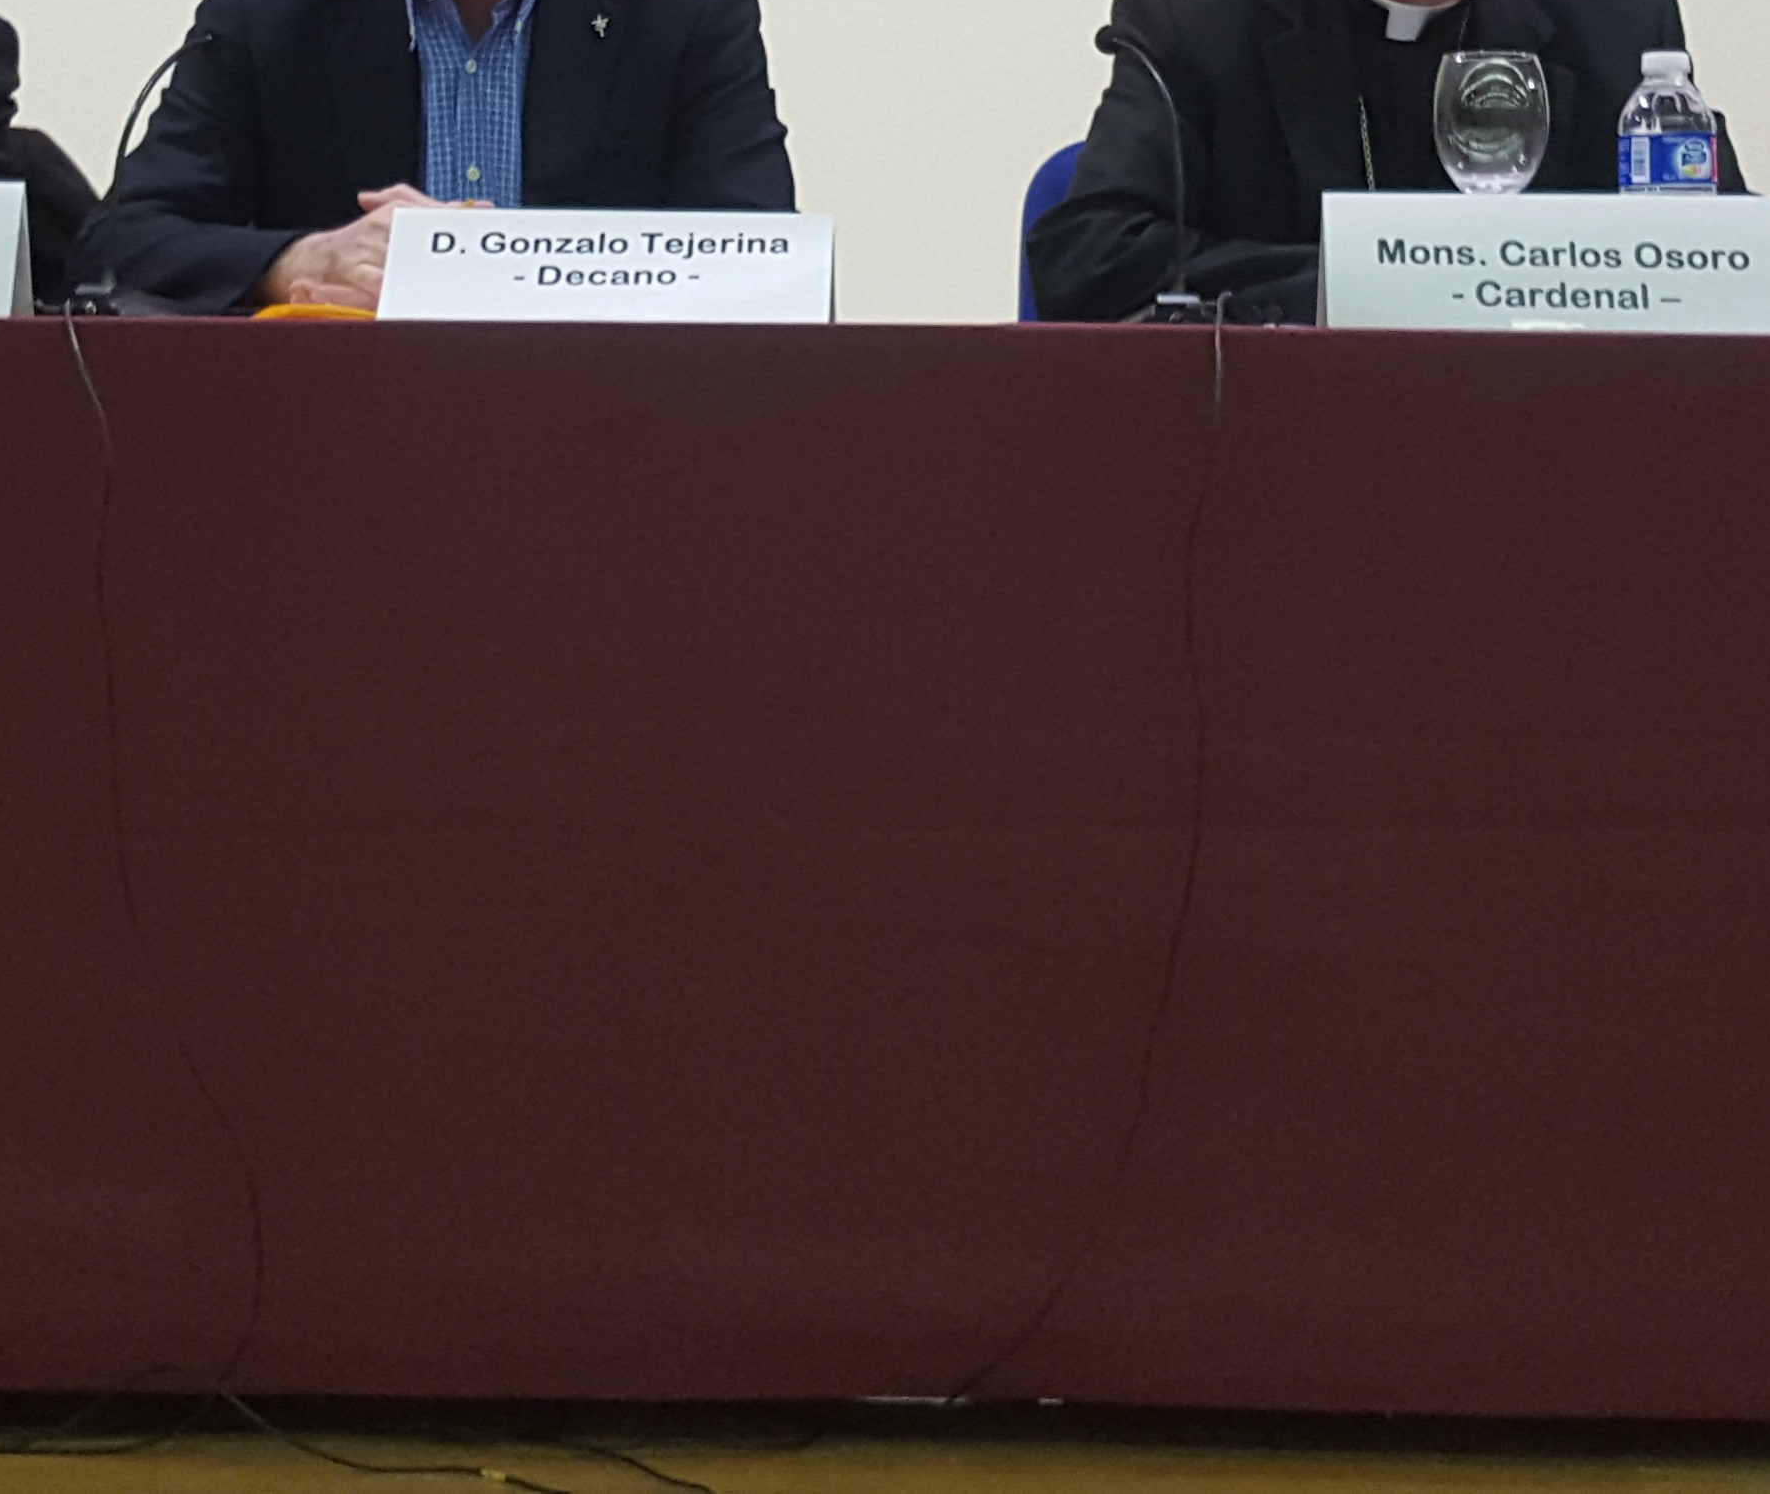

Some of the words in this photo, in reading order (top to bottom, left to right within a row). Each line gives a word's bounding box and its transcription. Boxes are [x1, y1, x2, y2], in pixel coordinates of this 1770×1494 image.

[432, 232, 465, 253] D.
[481, 232, 628, 253] Gonzalo
[641, 233, 788, 259] Tejerina
[1378, 239, 1486, 266] Mons.
[1500, 241, 1622, 268] Carlos
[1635, 243, 1749, 270] Osoro
[538, 266, 676, 285] Decano
[1476, 281, 1648, 309] Cardenal
